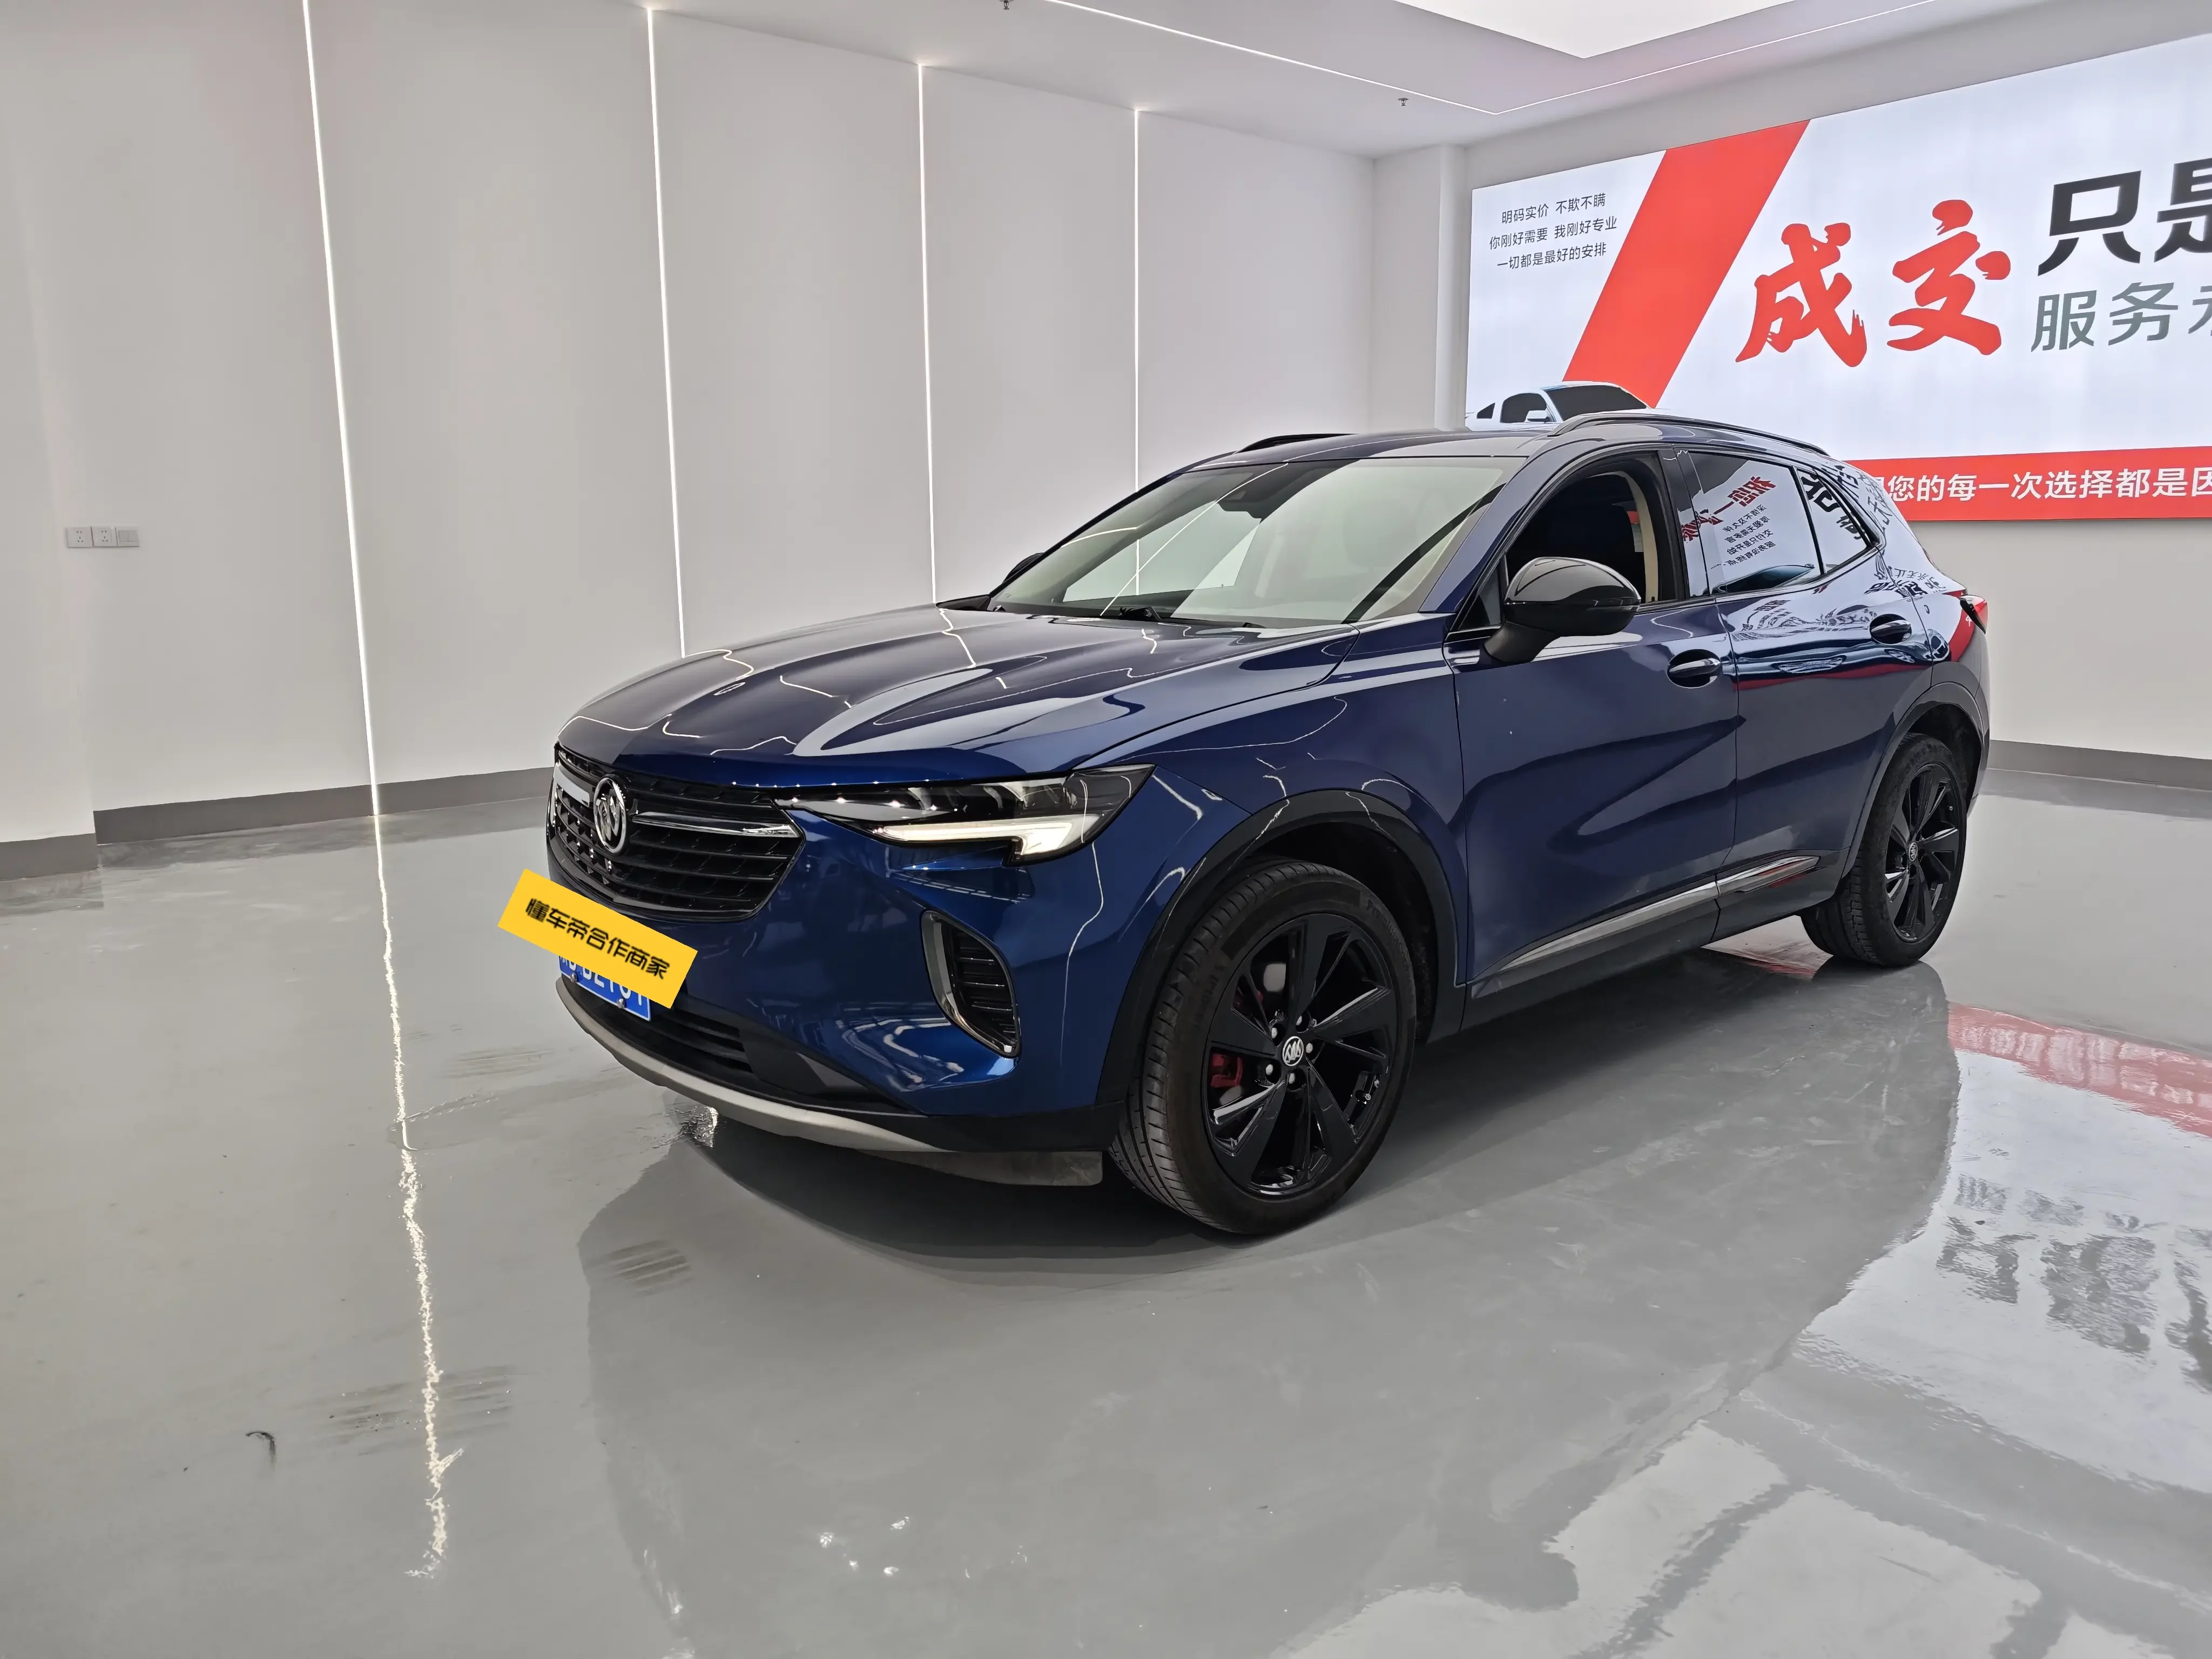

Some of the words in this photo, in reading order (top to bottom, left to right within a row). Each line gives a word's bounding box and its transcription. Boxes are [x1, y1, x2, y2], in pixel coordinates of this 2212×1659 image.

[1501, 203, 1549, 224] 明码实价
[1555, 192, 1606, 214] 不欺不瞒
[1489, 227, 1548, 250] 你刚好需要
[1554, 215, 1617, 239] 我刚好专业
[1497, 241, 1607, 269] 一切都是最好的安排
[1735, 199, 2011, 367] 成交
[1873, 467, 2212, 502] 您的每一次选择都是因
